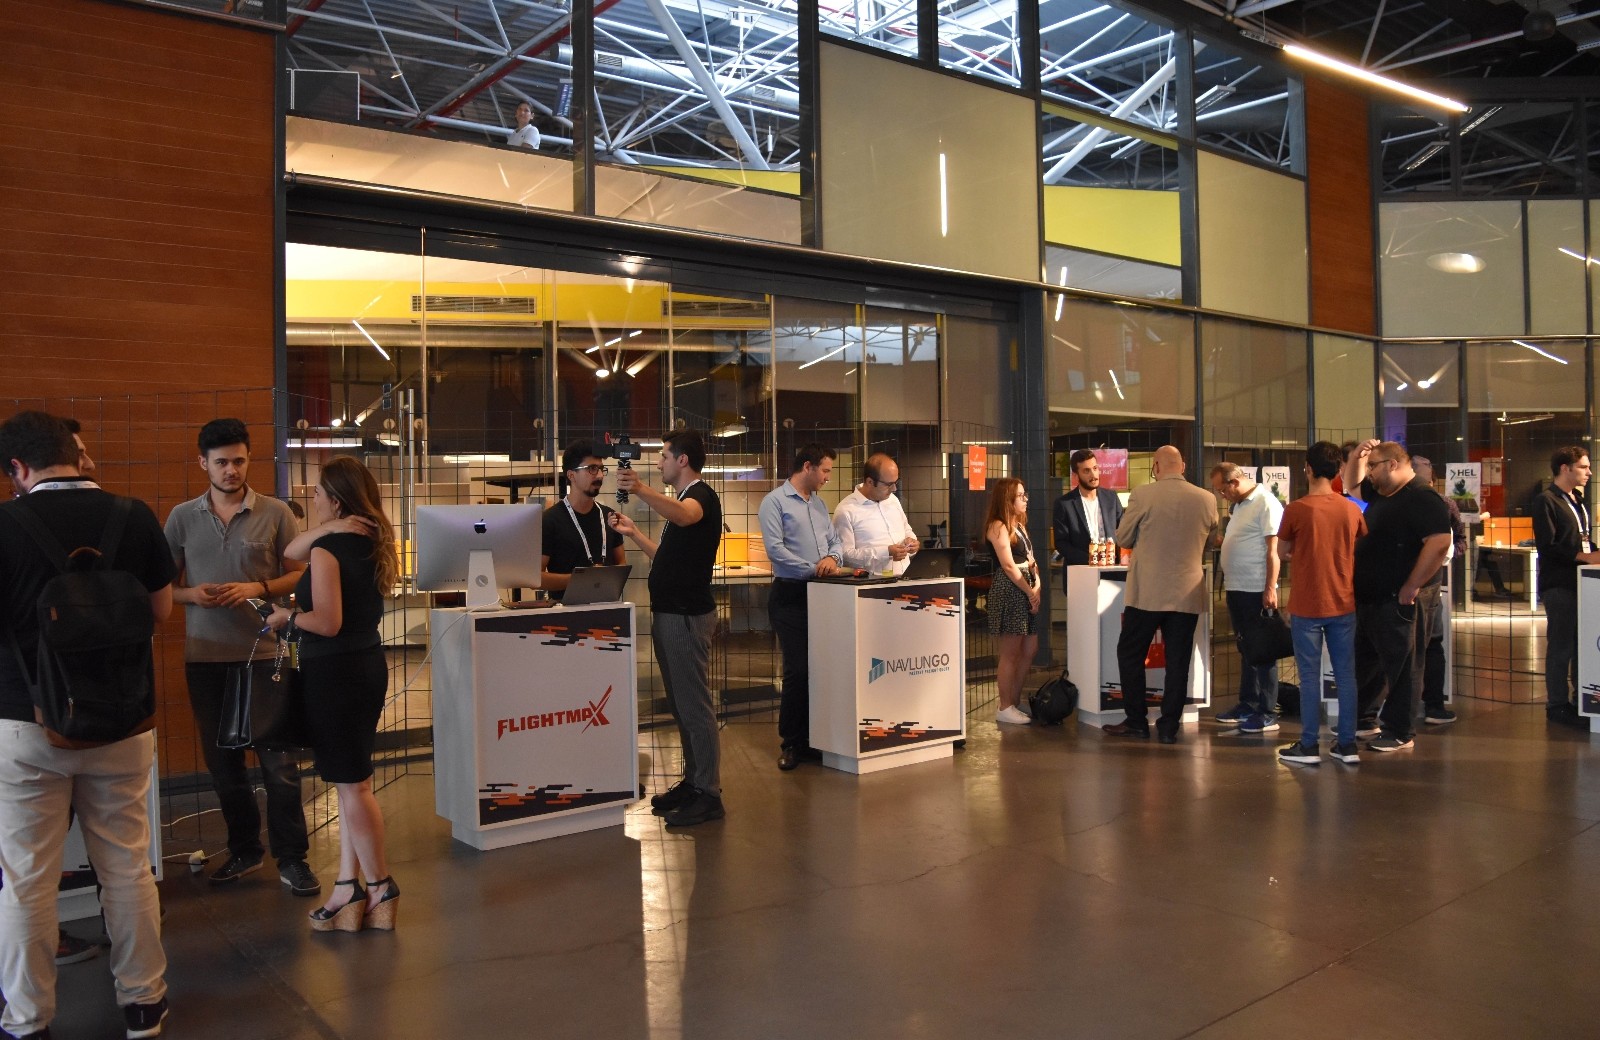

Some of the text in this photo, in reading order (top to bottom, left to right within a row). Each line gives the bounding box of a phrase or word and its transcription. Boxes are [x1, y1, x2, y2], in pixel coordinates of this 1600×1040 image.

[1271, 472, 1287, 480] HEL
[1457, 469, 1477, 477] HEL
[887, 653, 950, 674] NAVLUNGO
[497, 684, 612, 741] FLIGHTMAX
